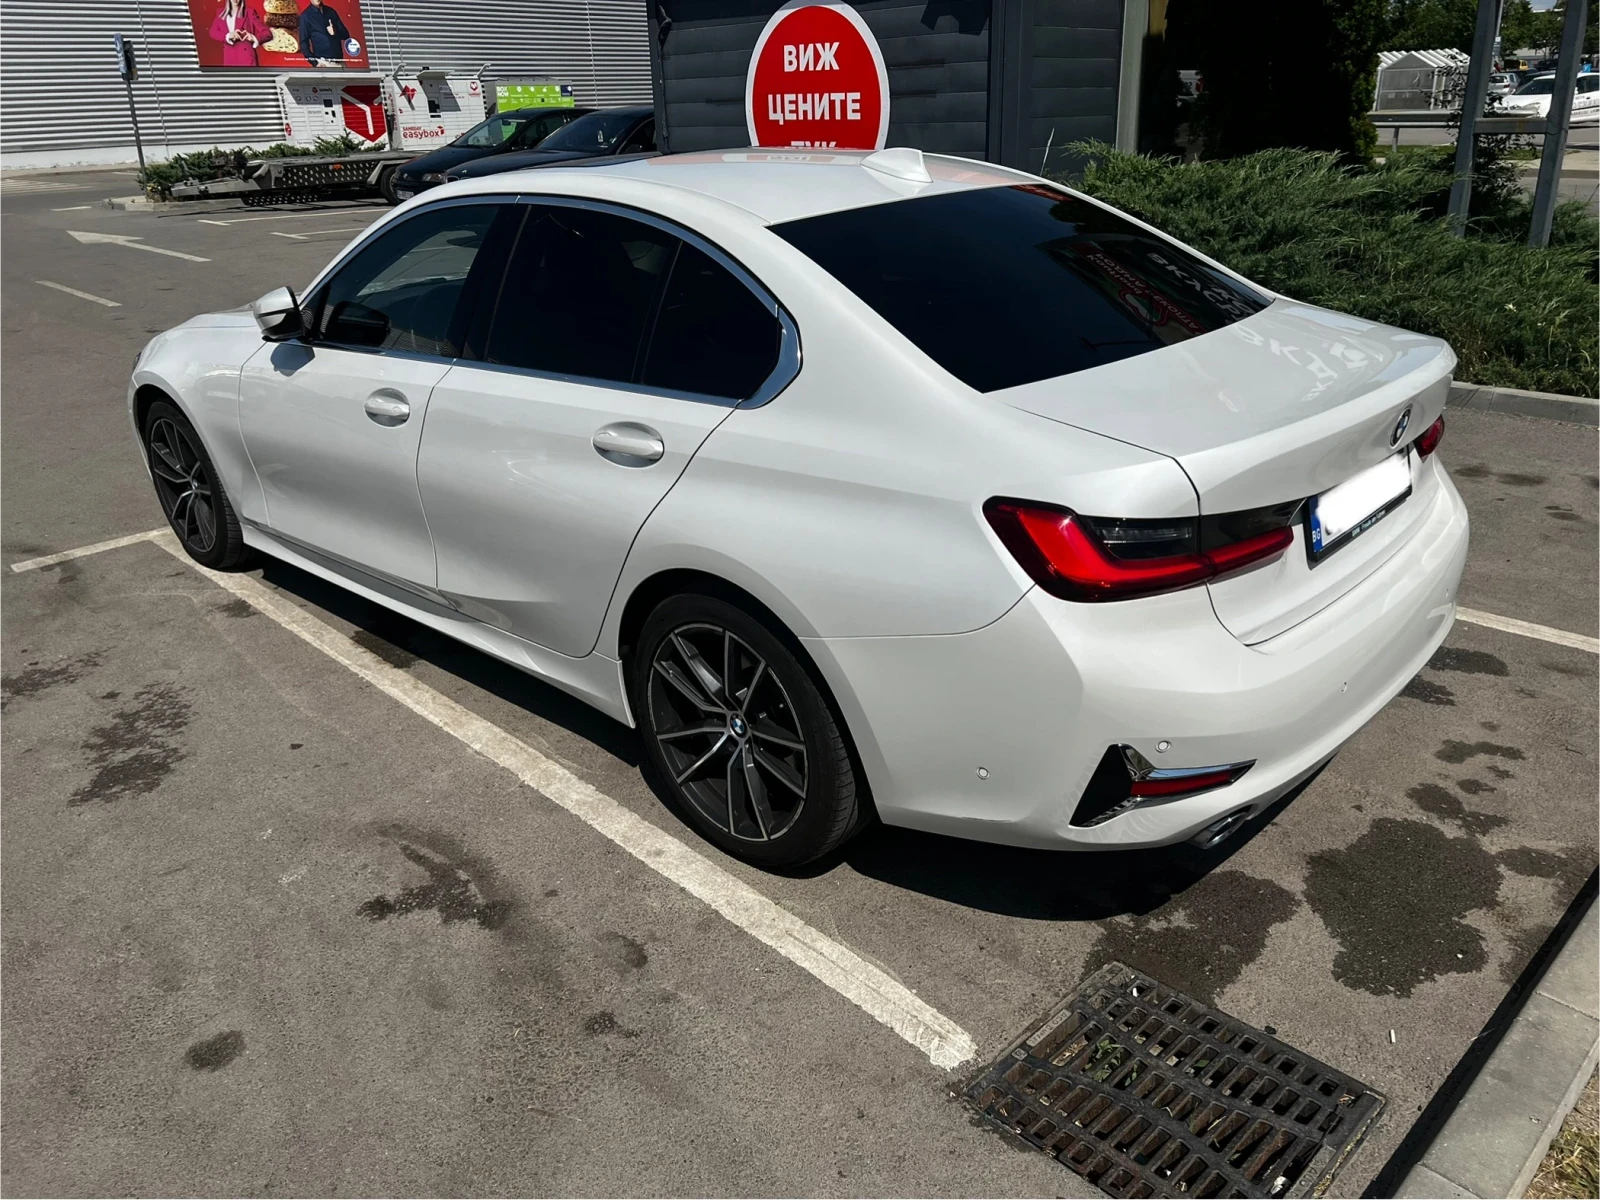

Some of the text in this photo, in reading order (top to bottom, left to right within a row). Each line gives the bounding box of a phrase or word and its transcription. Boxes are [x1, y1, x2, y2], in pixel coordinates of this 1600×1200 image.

[783, 41, 840, 72] ВИЖ
[767, 92, 861, 125] ЦЕНИТЕ
[402, 129, 440, 139] easybox
[1312, 528, 1321, 542] BG
